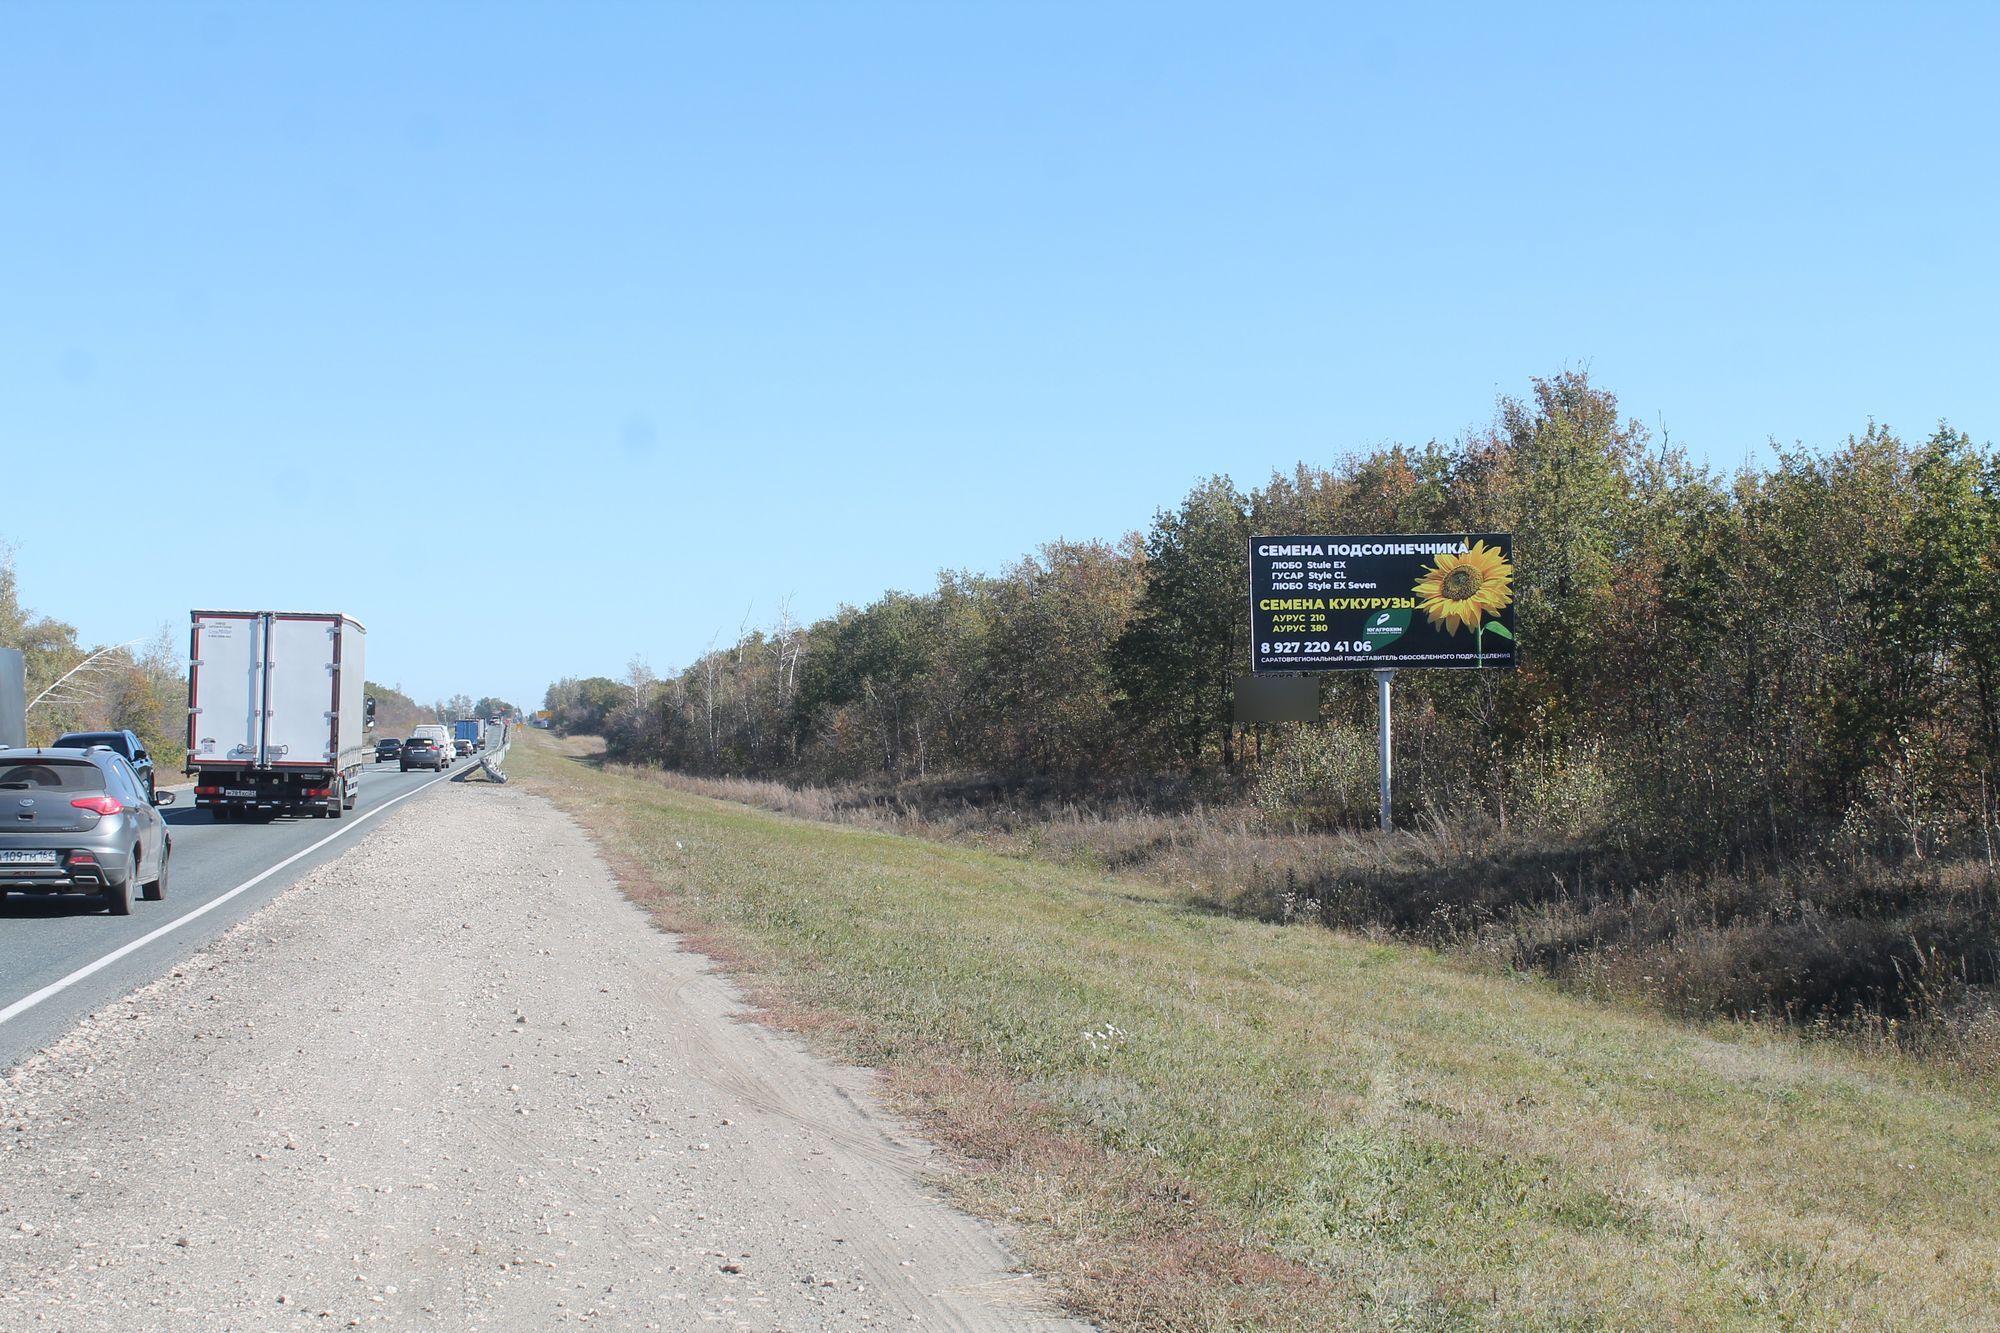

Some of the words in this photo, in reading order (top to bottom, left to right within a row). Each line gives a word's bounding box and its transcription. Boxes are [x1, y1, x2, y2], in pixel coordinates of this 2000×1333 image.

[1258, 544, 1324, 556] СЕМЕНА
[1327, 543, 1469, 557] ПОДСОЛНЕЧНИКА
[1271, 562, 1302, 570] ЛЮБО
[1333, 561, 1346, 569] EX
[1272, 572, 1304, 580] ГУСАР
[1308, 571, 1332, 581] Style
[1334, 571, 1347, 579] CL
[1272, 582, 1303, 590] ЛЮБО
[1307, 582, 1332, 591] Style
[1333, 582, 1347, 590] EX
[1348, 581, 1376, 590] Seven
[1259, 599, 1325, 610] СЕМЕНА
[1329, 597, 1415, 610] КУКУРУЗЫ
[1272, 614, 1306, 623] АУРУС
[1310, 614, 1326, 622] 210
[1273, 625, 1306, 633] АУРУС
[1310, 624, 1328, 632] 380
[1260, 642, 1270, 654] 8
[1274, 642, 1300, 653] 927
[1304, 641, 1330, 653] 220
[1334, 641, 1349, 652] 41
[1353, 640, 1372, 652] 06
[1344, 654, 1398, 662] ПРЕДСТАВИТЕЛЬ
